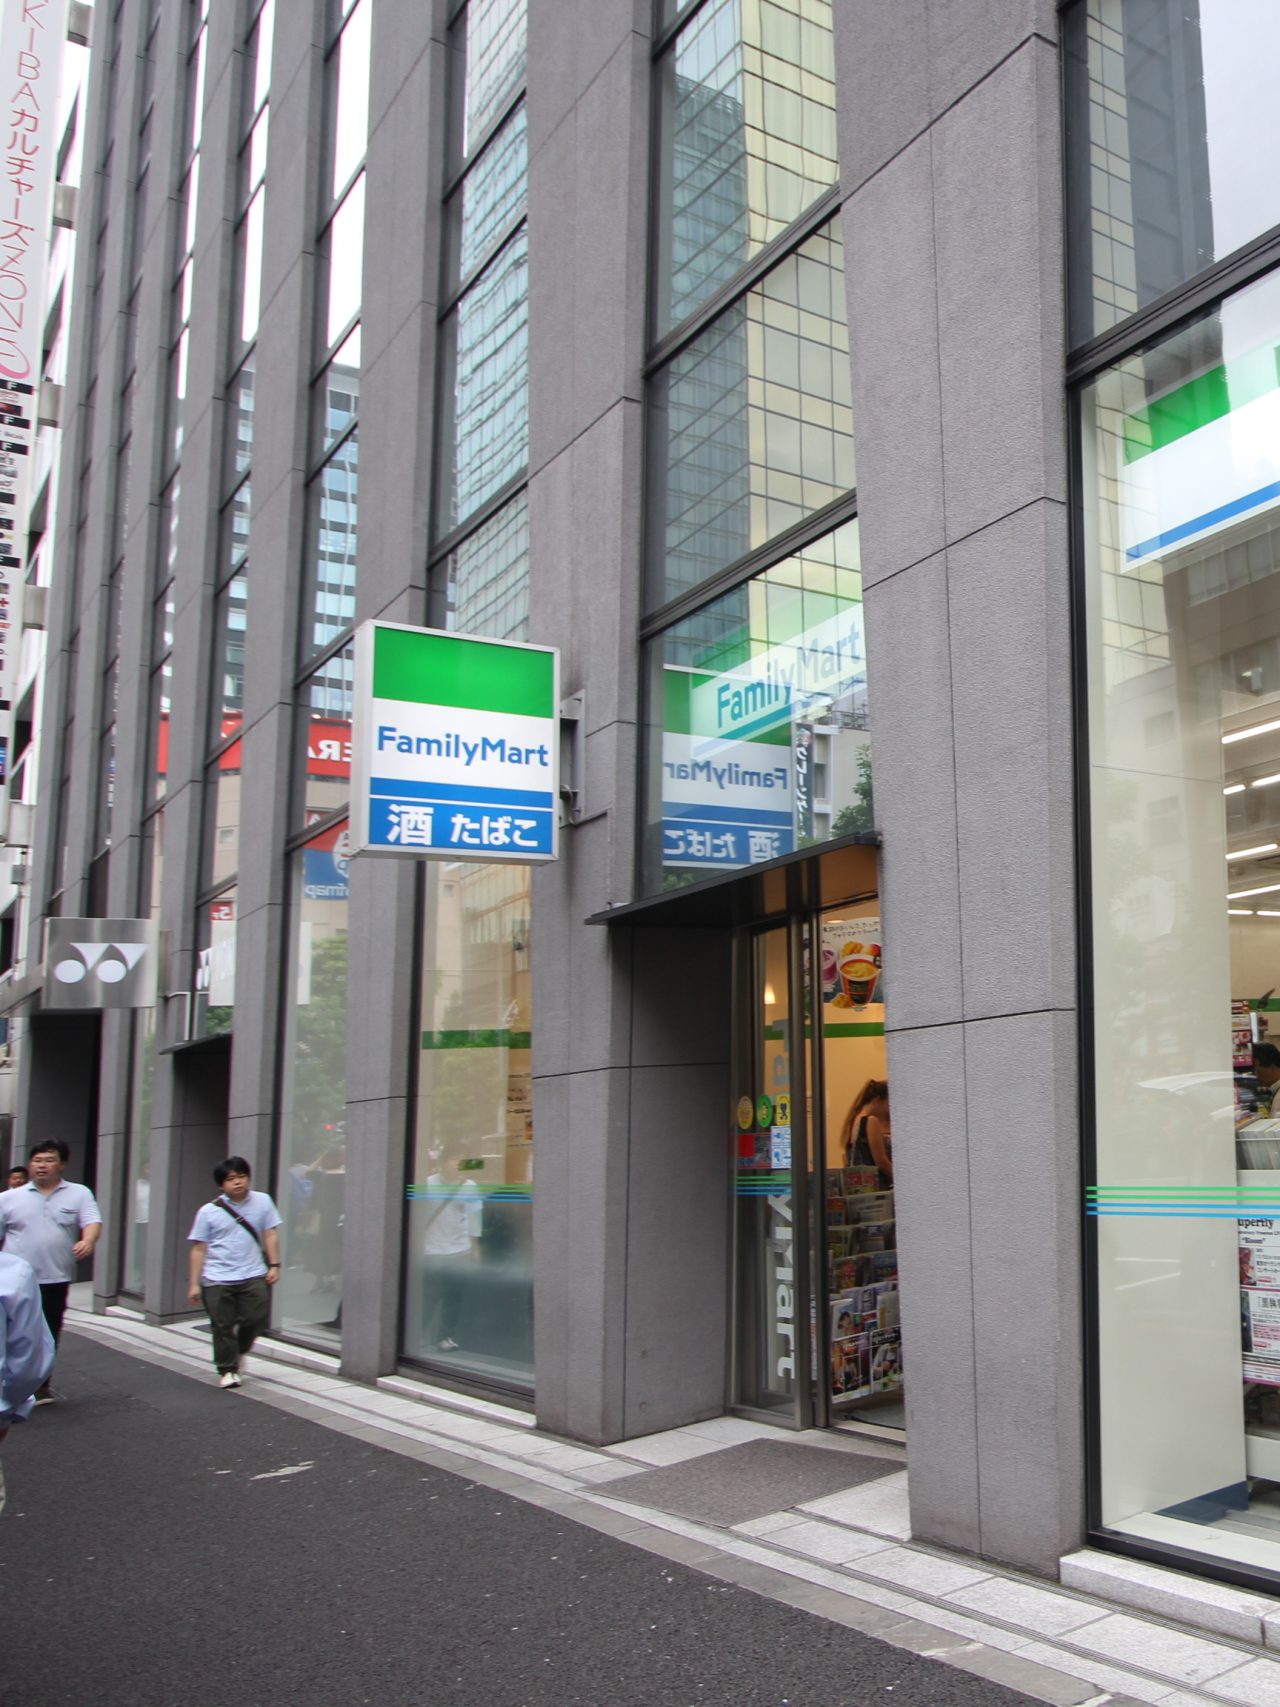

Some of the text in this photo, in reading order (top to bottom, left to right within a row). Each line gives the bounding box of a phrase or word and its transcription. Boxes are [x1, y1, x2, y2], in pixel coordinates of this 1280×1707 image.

[0, 0, 49, 357] KIBAカルチャーズZONE
[718, 622, 860, 729] FamilyMart
[377, 726, 549, 768] FamilyMart
[387, 804, 538, 848] 酒 たばこ
